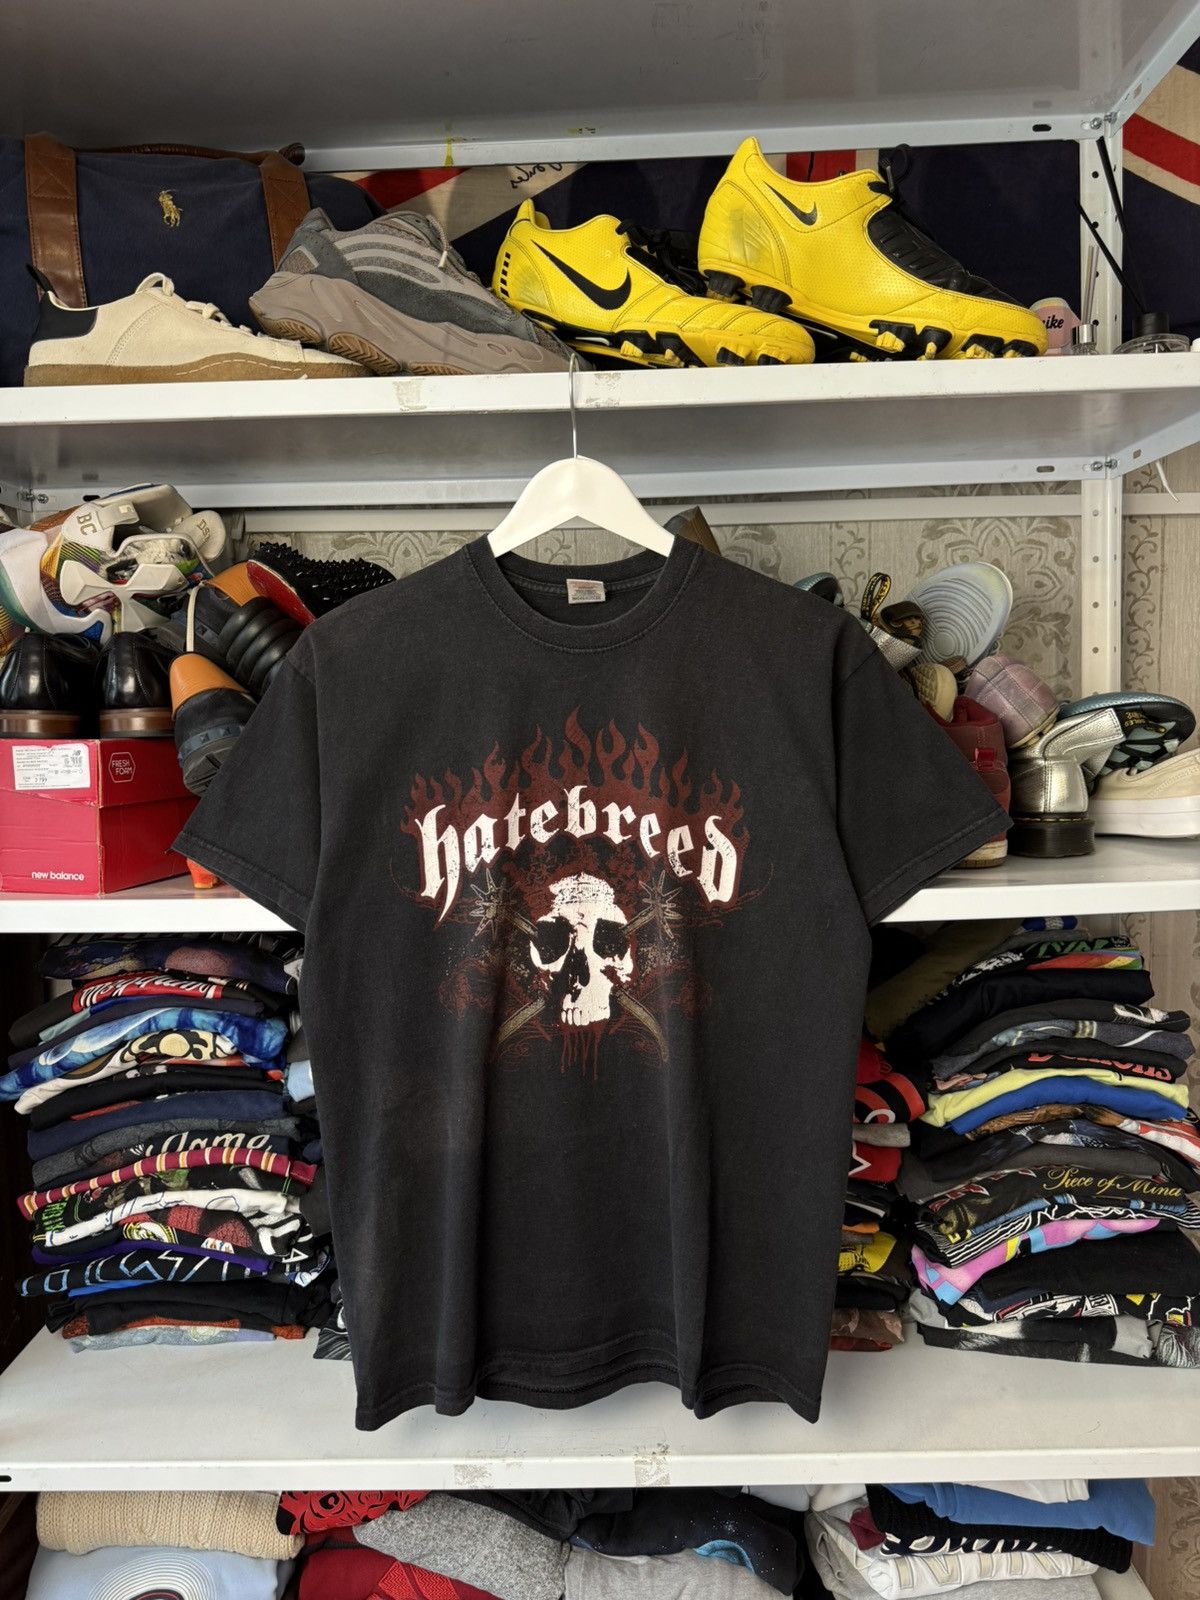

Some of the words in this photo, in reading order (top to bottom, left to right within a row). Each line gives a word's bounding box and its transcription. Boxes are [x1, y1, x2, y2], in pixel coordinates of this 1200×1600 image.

[1042, 315, 1065, 329] ike
[111, 759, 130, 768] FRESH
[115, 766, 132, 776] FOAM
[415, 785, 738, 922] hatebreed
[31, 871, 49, 880] new
[50, 871, 85, 881] balance
[1043, 1168, 1094, 1190] Piece
[1096, 1175, 1120, 1195] of
